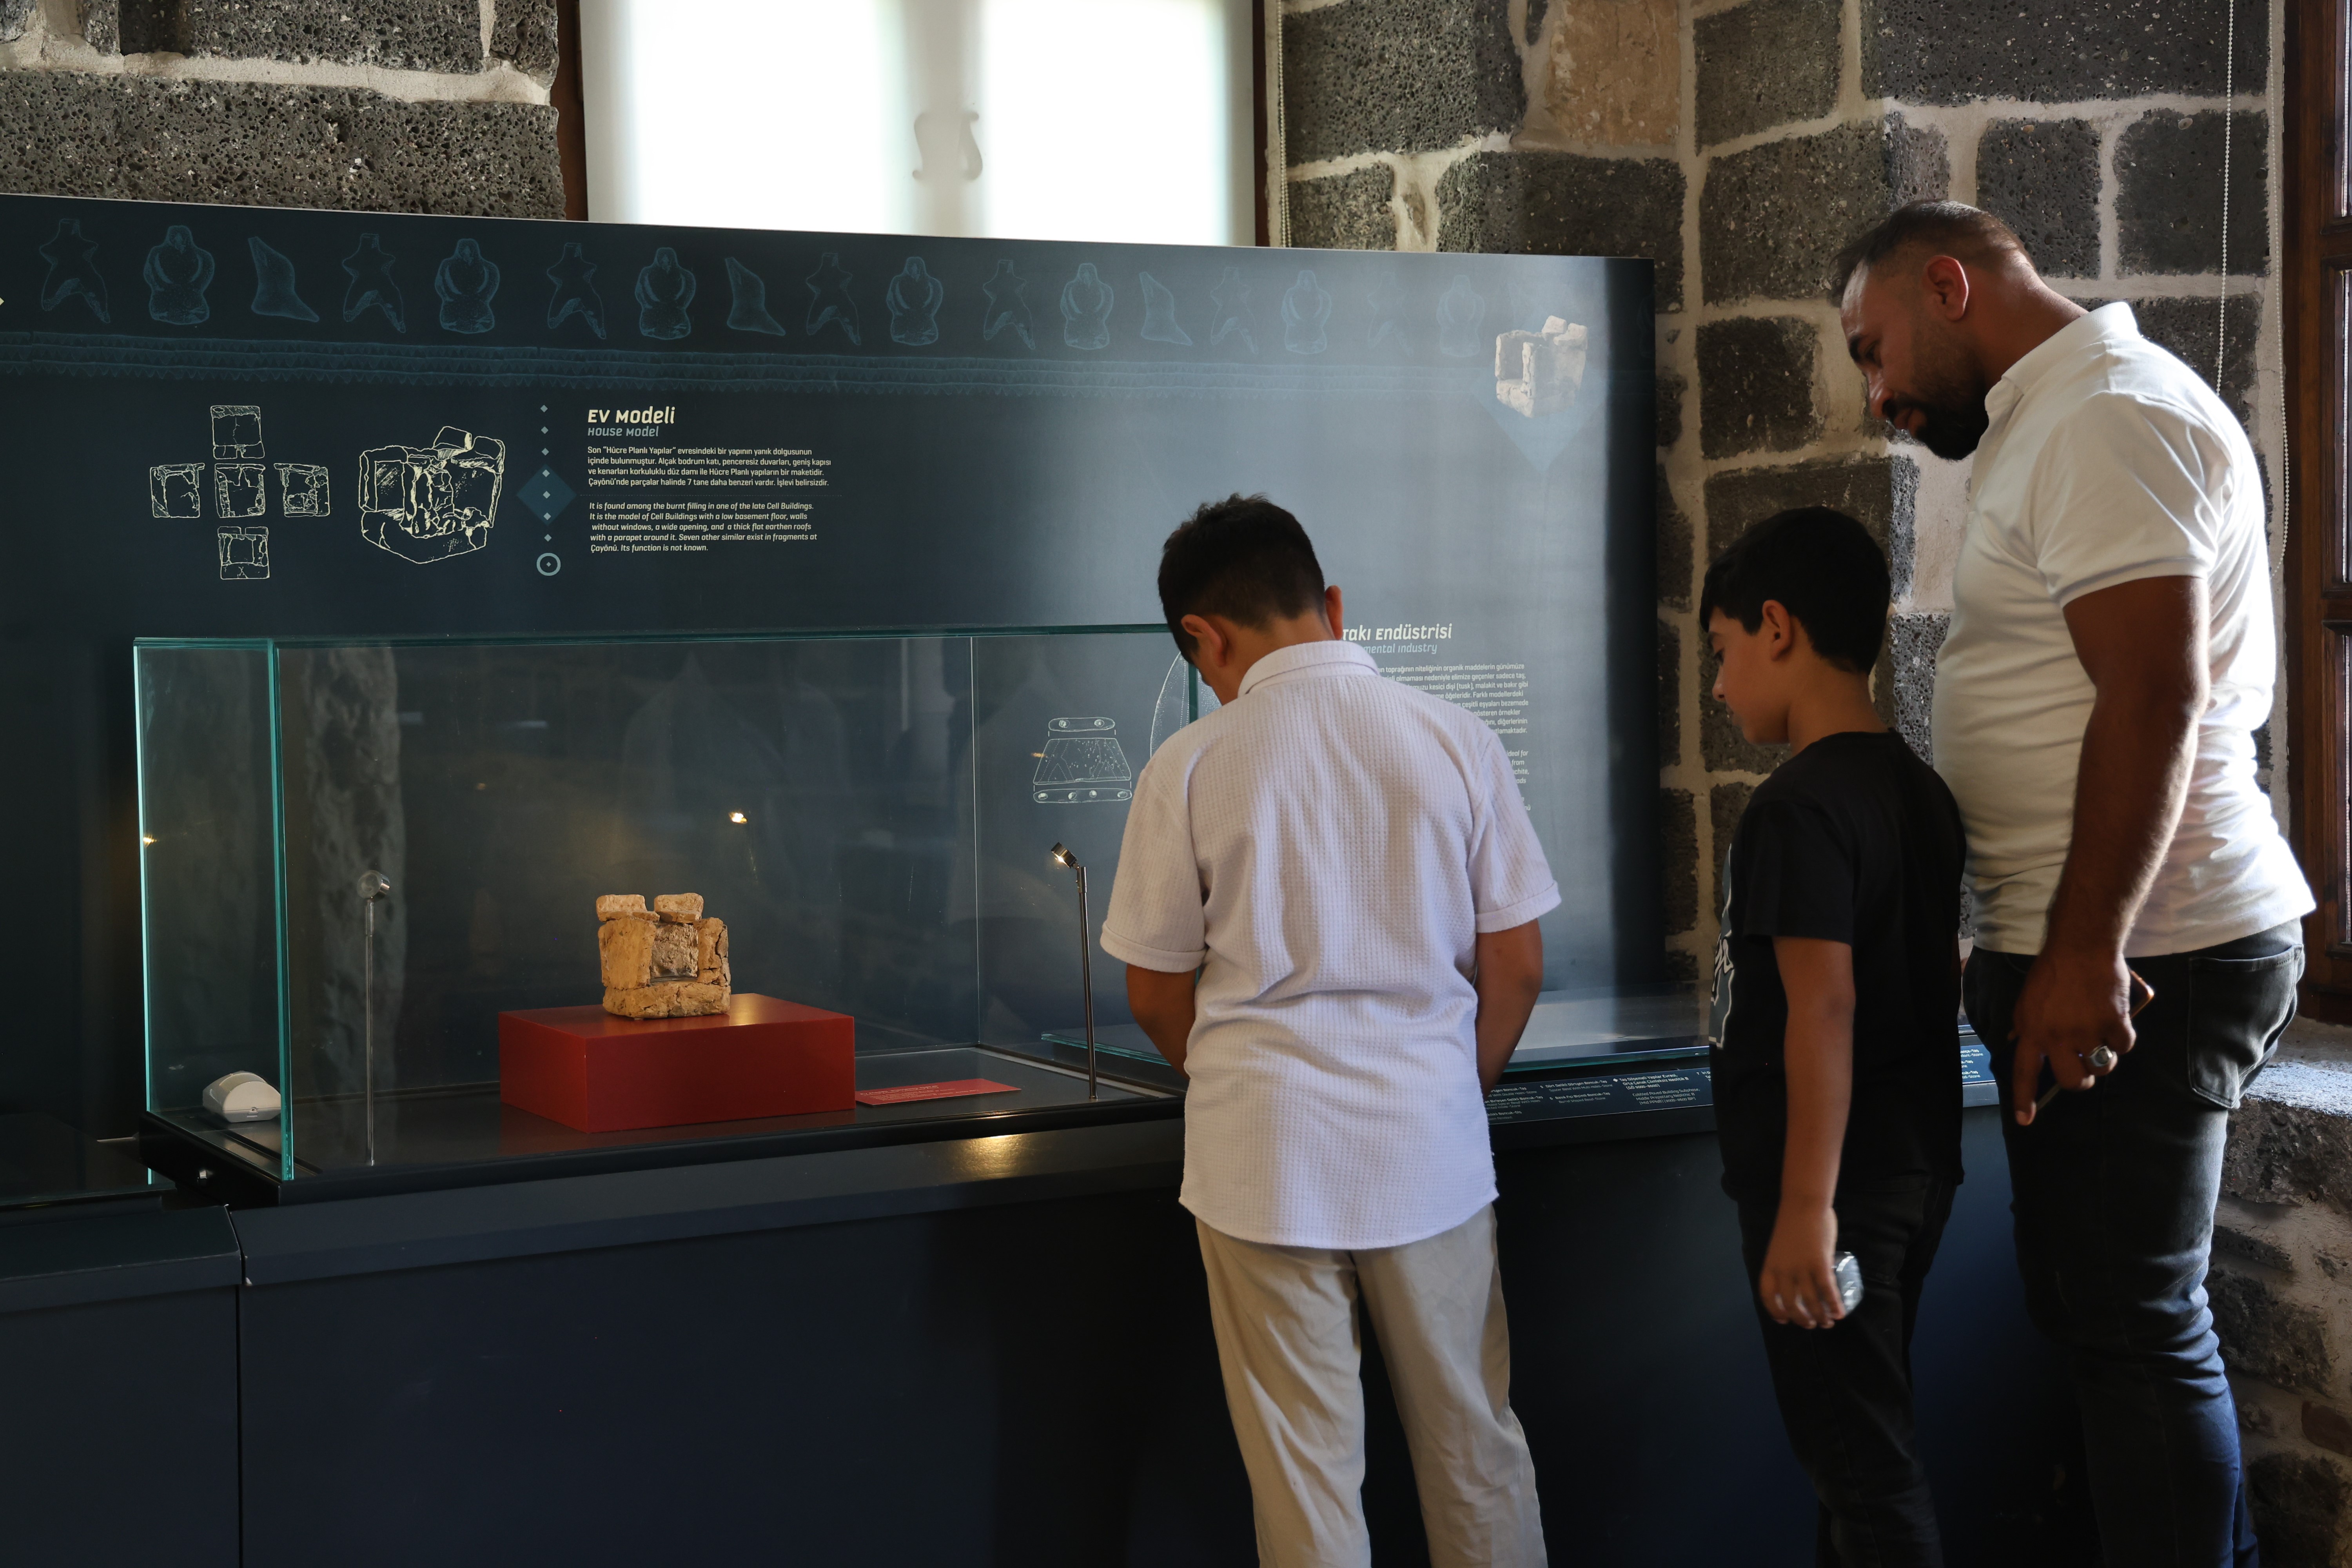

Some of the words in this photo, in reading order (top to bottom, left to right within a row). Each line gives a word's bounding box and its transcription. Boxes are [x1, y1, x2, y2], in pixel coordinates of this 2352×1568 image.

[615, 406, 675, 424] Modeli
[626, 426, 659, 437] Model
[754, 448, 772, 456] yanık
[773, 448, 812, 457] dolgusunun
[588, 457, 609, 466] içinde
[610, 457, 657, 466] bulunmuştur.
[658, 457, 677, 466] Alçak
[706, 457, 721, 466] katı,
[722, 458, 759, 466] penceresiz
[760, 458, 791, 466] duvarları,
[793, 458, 811, 467] geniş
[812, 458, 831, 467] kapısı
[750, 468, 779, 477] yapıların
[630, 478, 659, 487] parçalar
[777, 477, 794, 488] İşlevi
[604, 502, 625, 511] found
[687, 502, 707, 511] filling
[730, 502, 738, 511] of
[781, 502, 814, 511] Buildings.
[642, 513, 650, 521] of
[665, 513, 697, 522] Buildings
[771, 512, 788, 521] floor,
[621, 523, 653, 531] windows,
[679, 523, 709, 532] opening,
[752, 523, 764, 532] flat
[793, 523, 811, 532] roofs
[613, 534, 642, 543] parapet
[773, 533, 808, 542] fragments
[591, 544, 619, 553] Çayönü.
[632, 544, 661, 553] function
[1376, 623, 1452, 640] Endüstrisi
